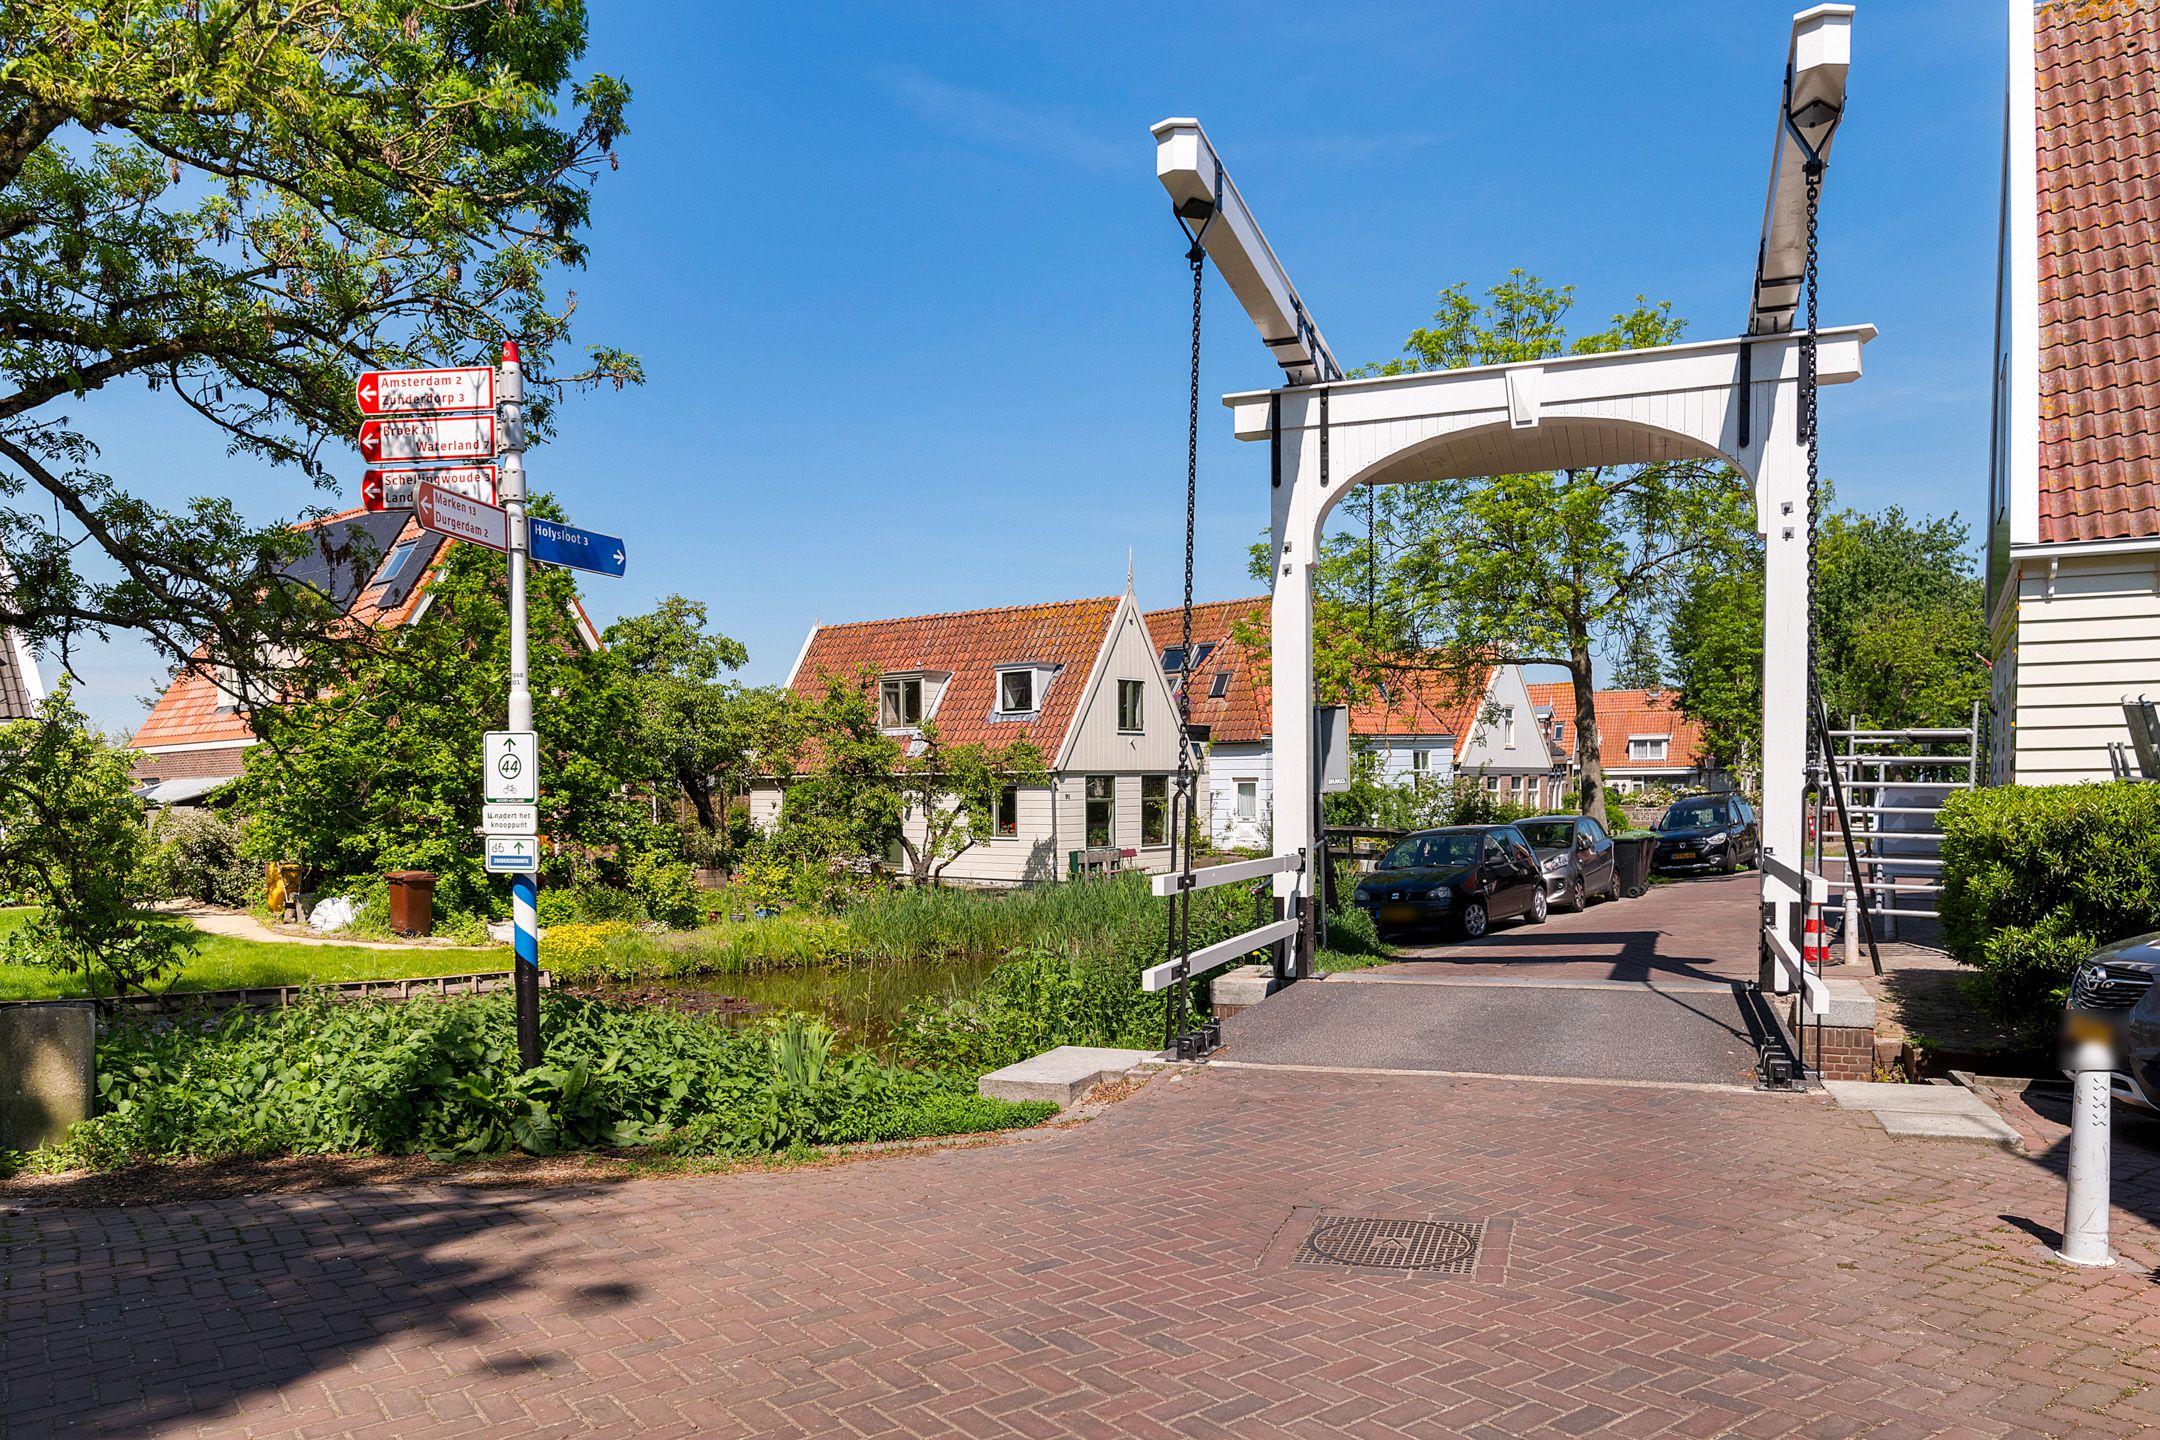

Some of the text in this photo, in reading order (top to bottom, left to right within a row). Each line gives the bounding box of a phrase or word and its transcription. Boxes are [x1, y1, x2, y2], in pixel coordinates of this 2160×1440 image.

[381, 376, 462, 388] Amsterdam 2
[382, 393, 464, 406] Zunderdorp 3
[384, 424, 433, 436] Broek in
[416, 440, 490, 452] Waterland 7
[485, 473, 490, 482] 3
[435, 491, 476, 516] Marken 13
[436, 511, 488, 538] Durgerdam 2
[535, 523, 589, 546] Holysloot 3
[501, 760, 518, 773] 44
[490, 821, 528, 829] knooppunt
